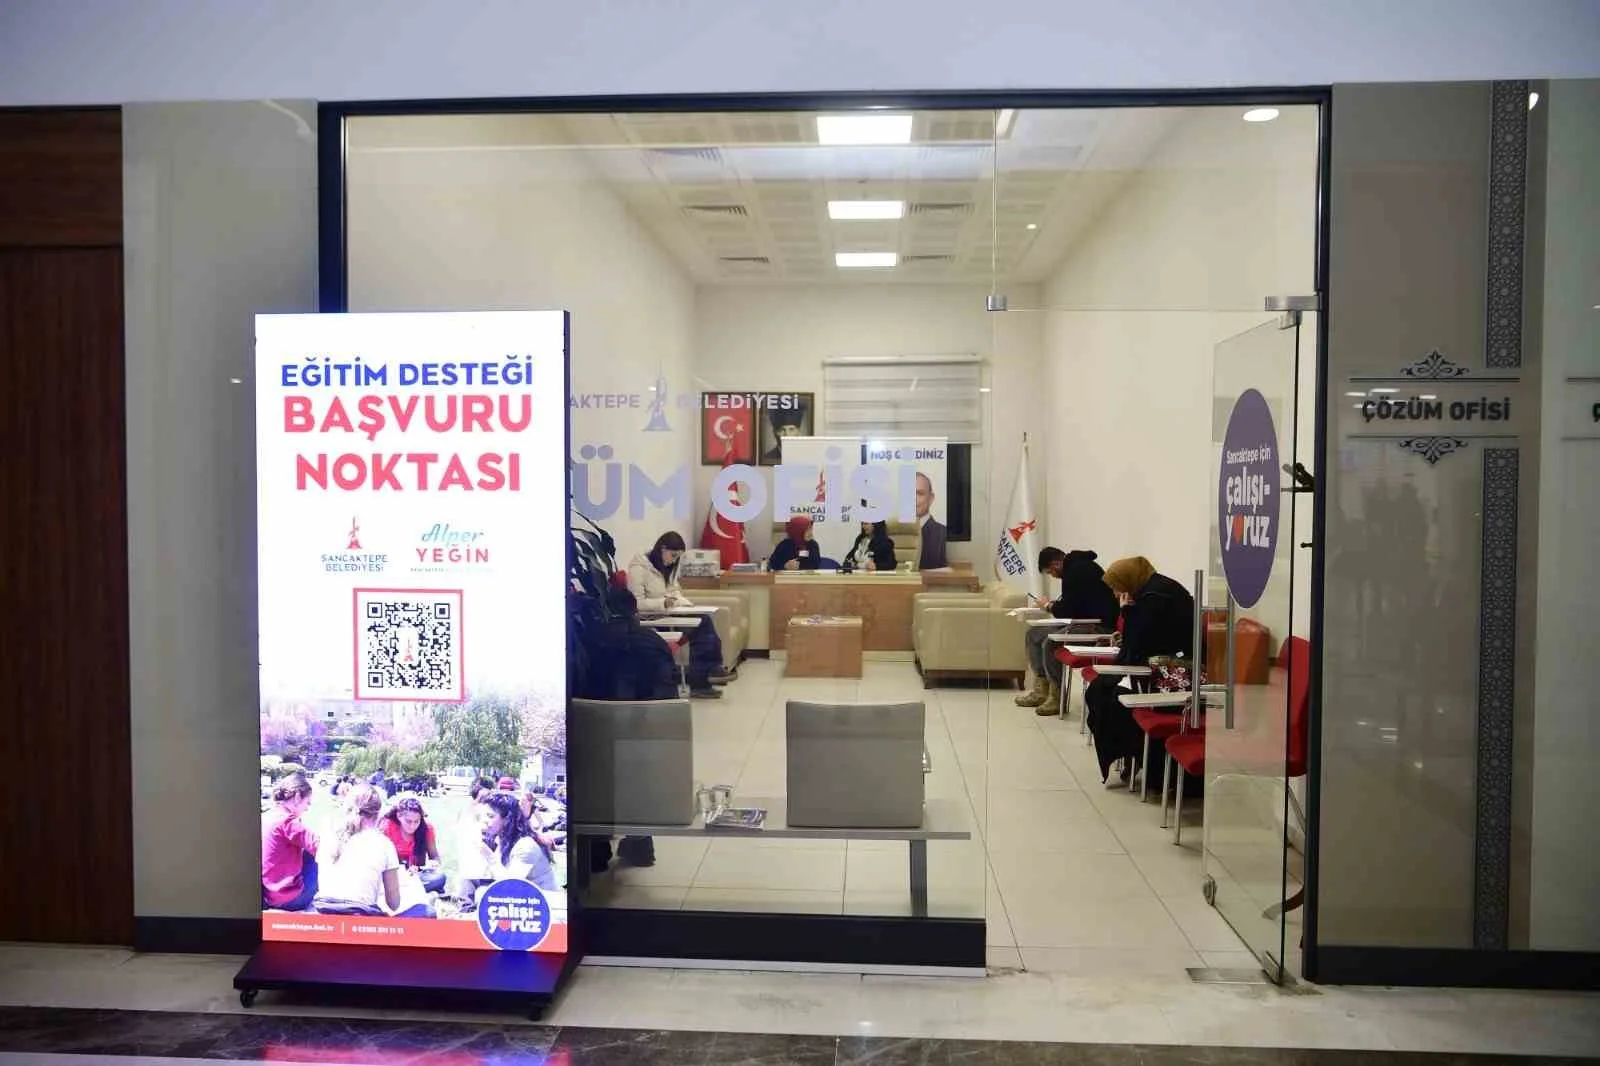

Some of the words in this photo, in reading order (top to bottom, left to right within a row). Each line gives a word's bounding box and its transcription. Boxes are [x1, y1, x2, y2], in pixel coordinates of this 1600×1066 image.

[281, 356, 388, 387] EĞİTİM
[399, 354, 533, 386] DESTEĞİ
[284, 394, 533, 441] BAŞVURU
[1361, 396, 1443, 423] ÇÖZÜM
[1450, 397, 1511, 421] OFİSİ
[894, 449, 945, 460] GDİNİZ
[296, 452, 521, 492] NOKTASI
[711, 444, 917, 524] OFİSİ
[421, 523, 485, 547] Alper
[321, 554, 389, 564] SANCAKTEPE
[415, 544, 490, 564] YEĞİN
[325, 563, 384, 573] BELEDİYESİ
